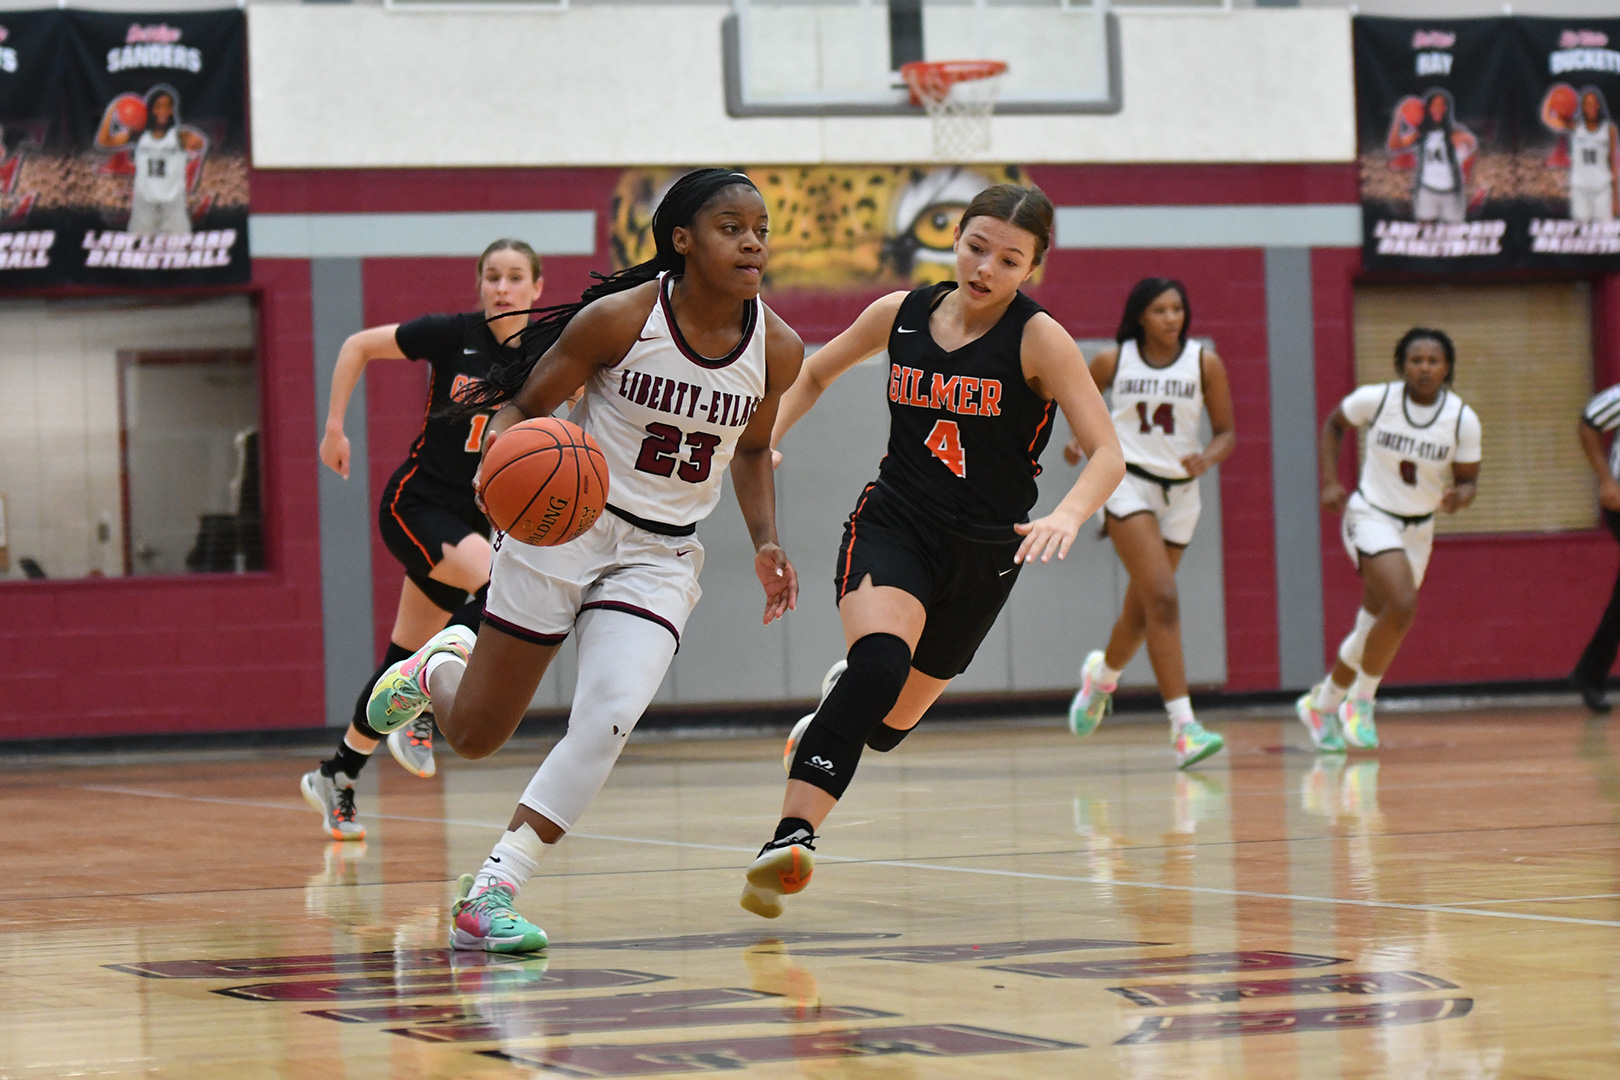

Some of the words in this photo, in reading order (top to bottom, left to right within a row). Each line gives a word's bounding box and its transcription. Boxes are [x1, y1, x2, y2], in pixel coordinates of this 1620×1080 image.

[106, 44, 202, 73] SANDERS
[85, 249, 231, 269] BASKETBALL
[889, 363, 1002, 416] GILMER
[1135, 401, 1175, 435] 14
[634, 422, 722, 483] 23
[924, 419, 966, 478] 4
